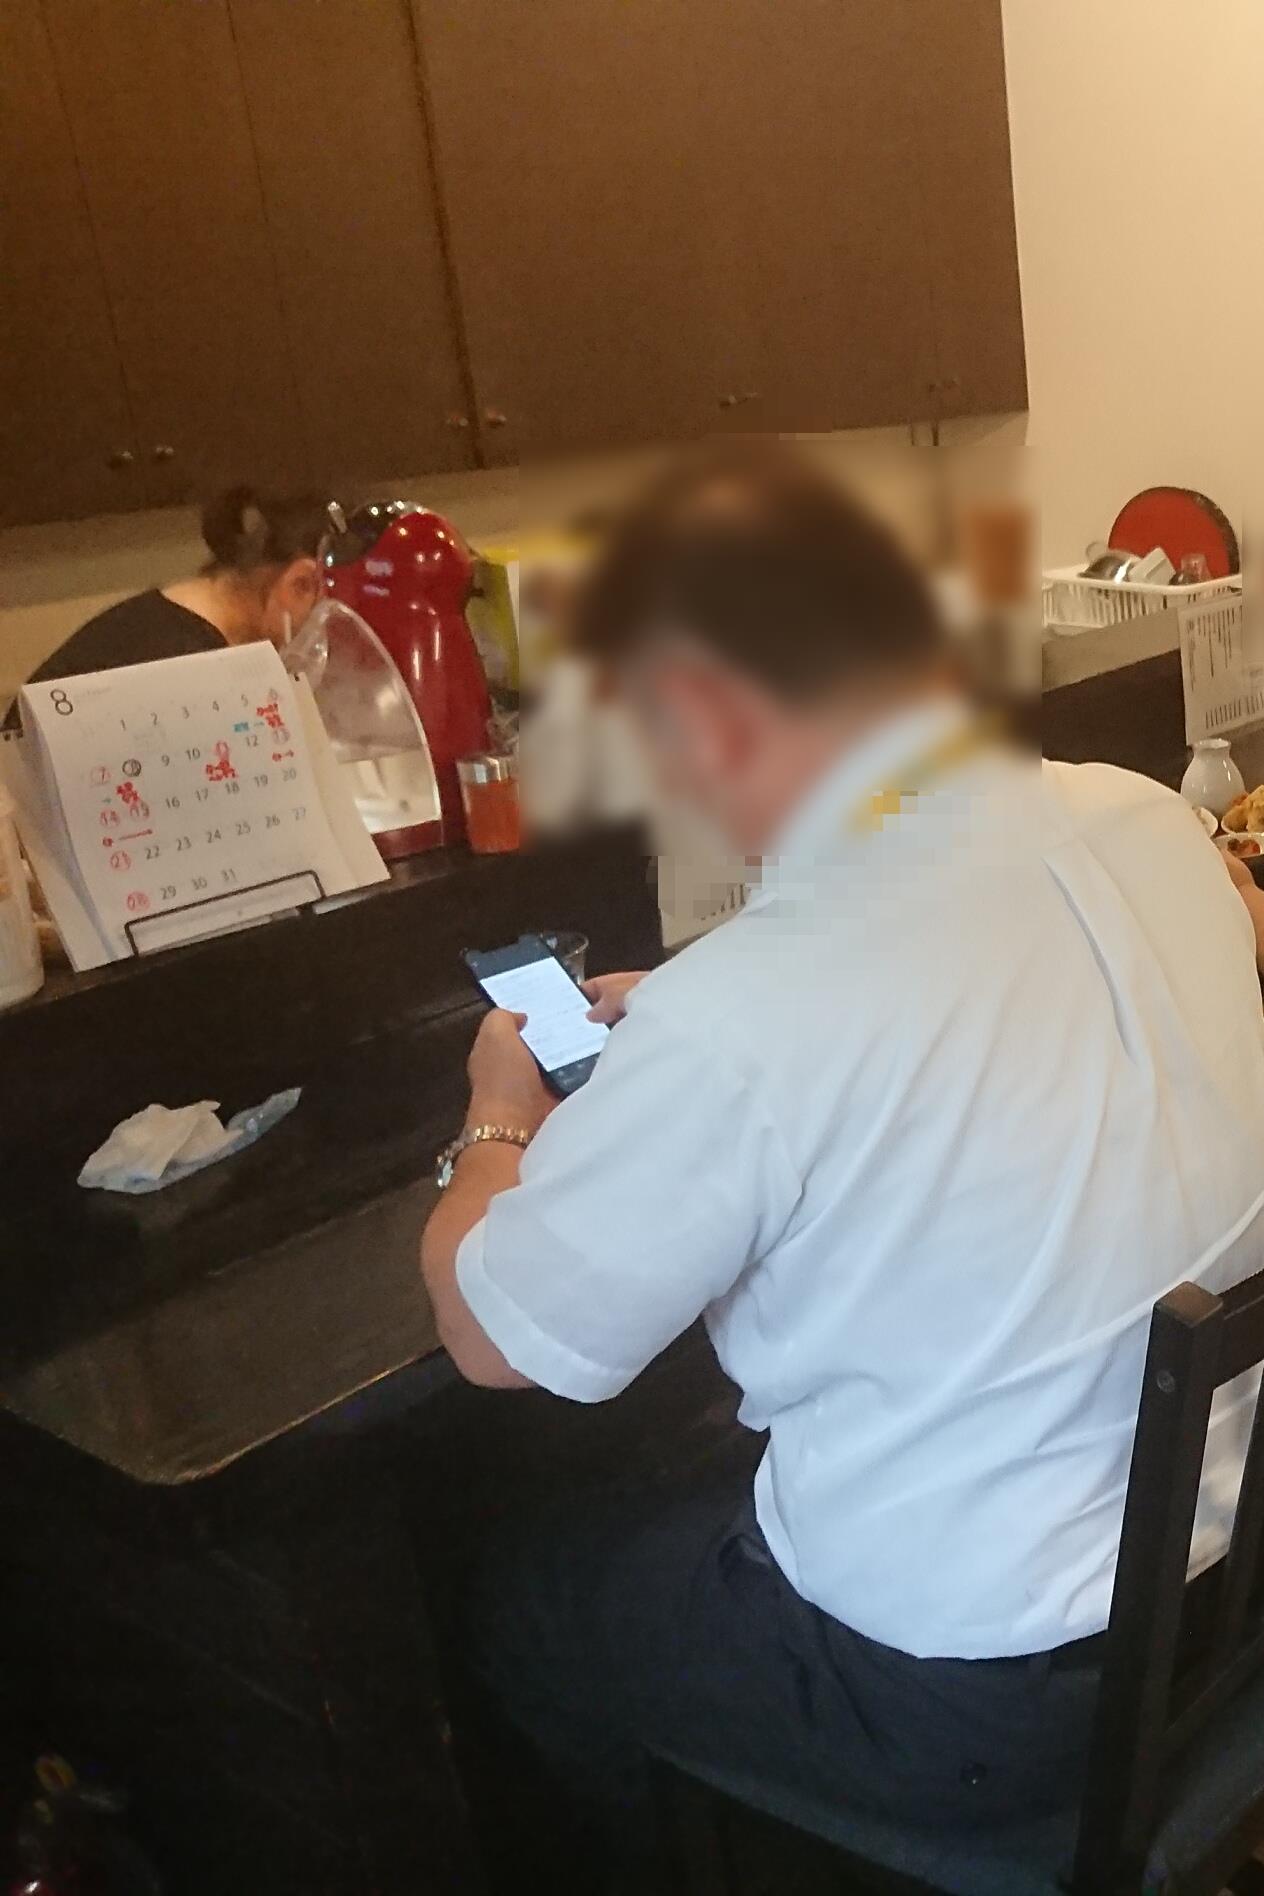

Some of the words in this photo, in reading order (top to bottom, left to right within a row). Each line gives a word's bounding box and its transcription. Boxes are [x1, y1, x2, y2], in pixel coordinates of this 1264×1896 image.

[50, 689, 73, 715] 8
[120, 718, 127, 732] 1
[150, 711, 159, 726] 2
[181, 706, 191, 719] 3
[211, 700, 220, 712] 4
[240, 693, 249, 707] 5
[160, 754, 170, 767] 9
[184, 747, 200, 761] 10
[244, 734, 259, 748] 12
[165, 797, 181, 809] 16
[195, 787, 209, 801] 17
[225, 781, 240, 795] 18
[253, 773, 270, 788] 19
[282, 767, 297, 782] 20
[145, 845, 160, 860] 22
[176, 836, 192, 852] 23
[206, 829, 222, 844] 24
[235, 821, 251, 836] 25
[264, 814, 281, 829] 26
[160, 885, 177, 900] 29
[192, 877, 208, 891] 30
[222, 868, 237, 882] 31
